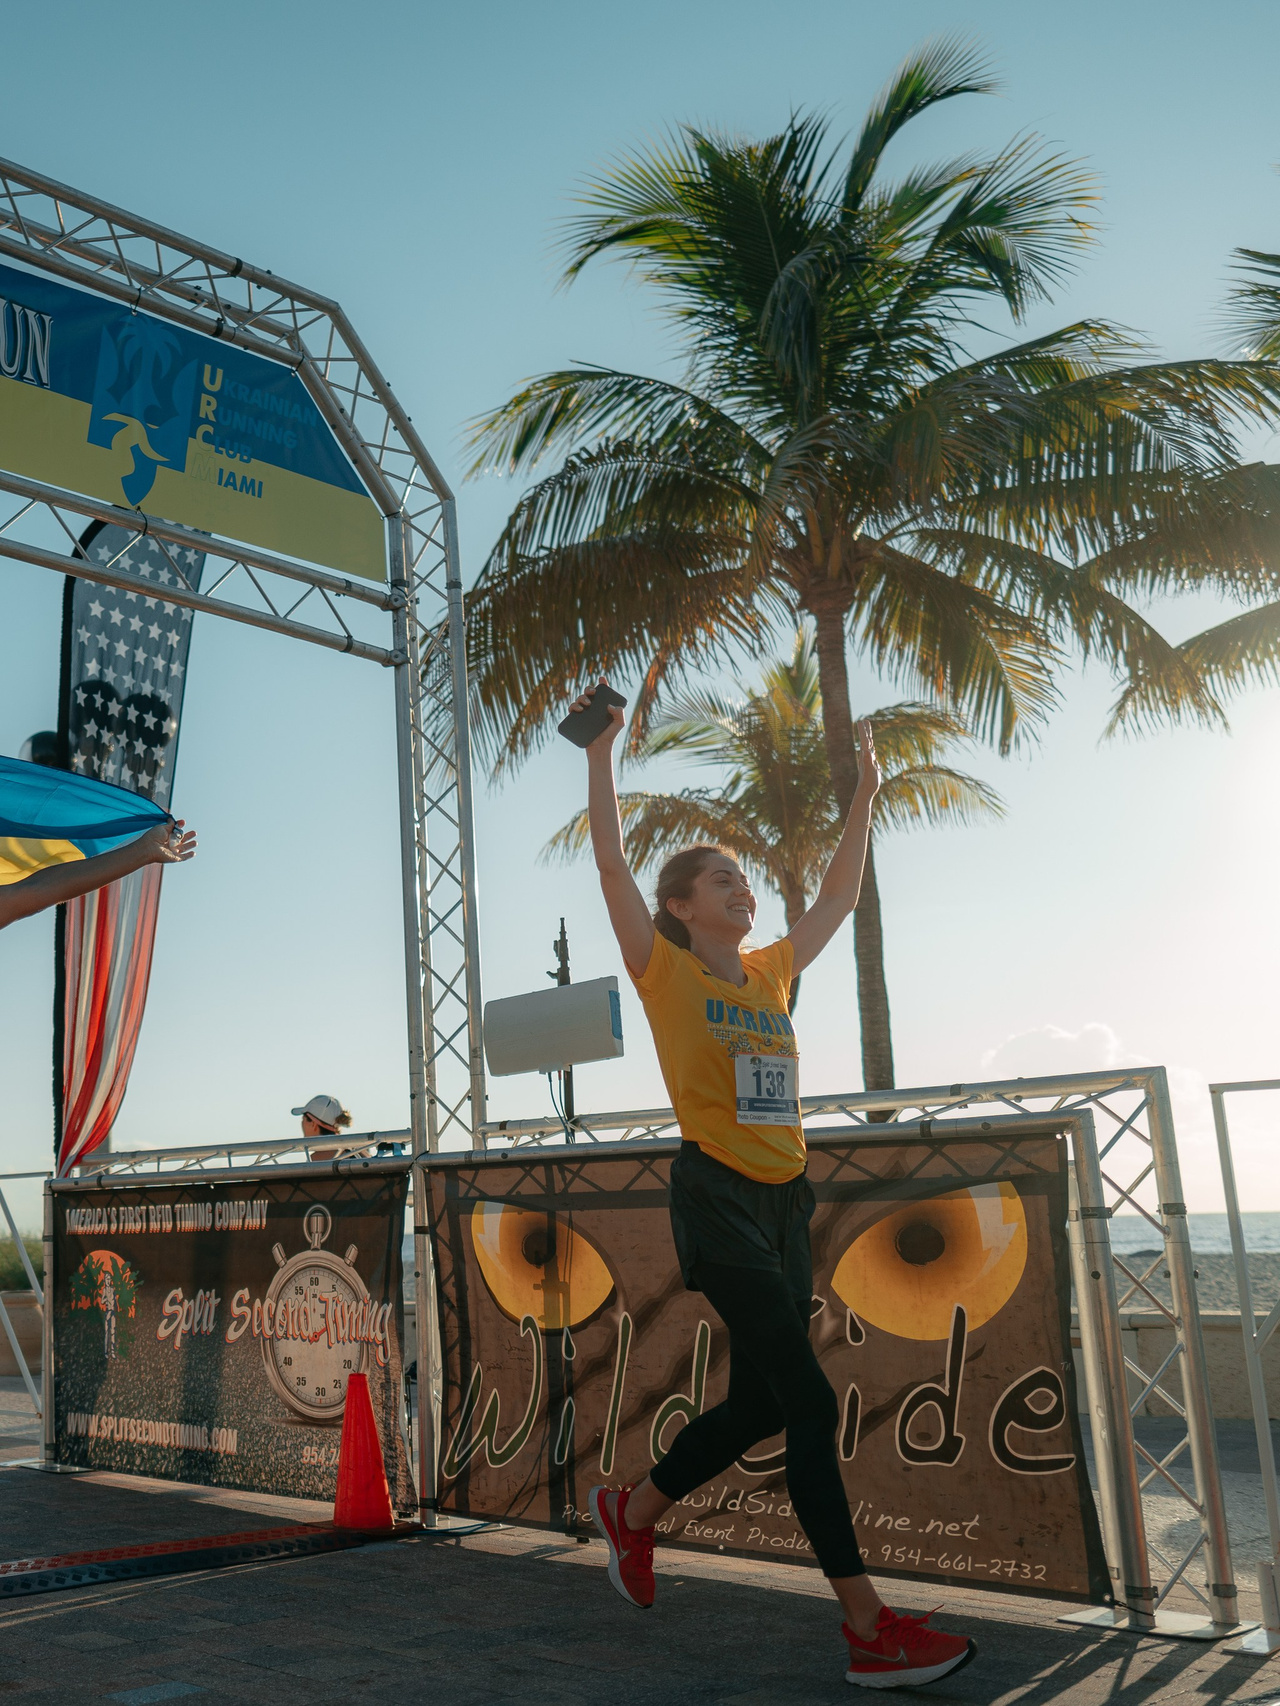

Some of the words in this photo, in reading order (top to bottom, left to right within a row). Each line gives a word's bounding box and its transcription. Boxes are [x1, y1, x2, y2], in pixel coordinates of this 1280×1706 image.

[706, 998, 795, 1036] UKRAIN
[752, 1069, 786, 1098] 138
[65, 1206, 117, 1236] AMERICA'S
[119, 1205, 147, 1235] FIRST
[174, 1202, 212, 1233] TIMING
[214, 1200, 269, 1232] COMPANY
[294, 1286, 304, 1296] 55
[309, 1277, 319, 1287] 60
[156, 1287, 221, 1350] Split
[225, 1287, 311, 1344] Second
[318, 1291, 393, 1367] Timing
[283, 1357, 293, 1366] 40
[343, 1359, 352, 1369] 20
[296, 1377, 307, 1386] 35
[315, 1387, 326, 1397] 30
[67, 1412, 238, 1456] WWW.SPLITSECONDTIMING.COM
[684, 1519, 735, 1542] Event
[880, 1543, 1048, 1583] 954-661-2732
